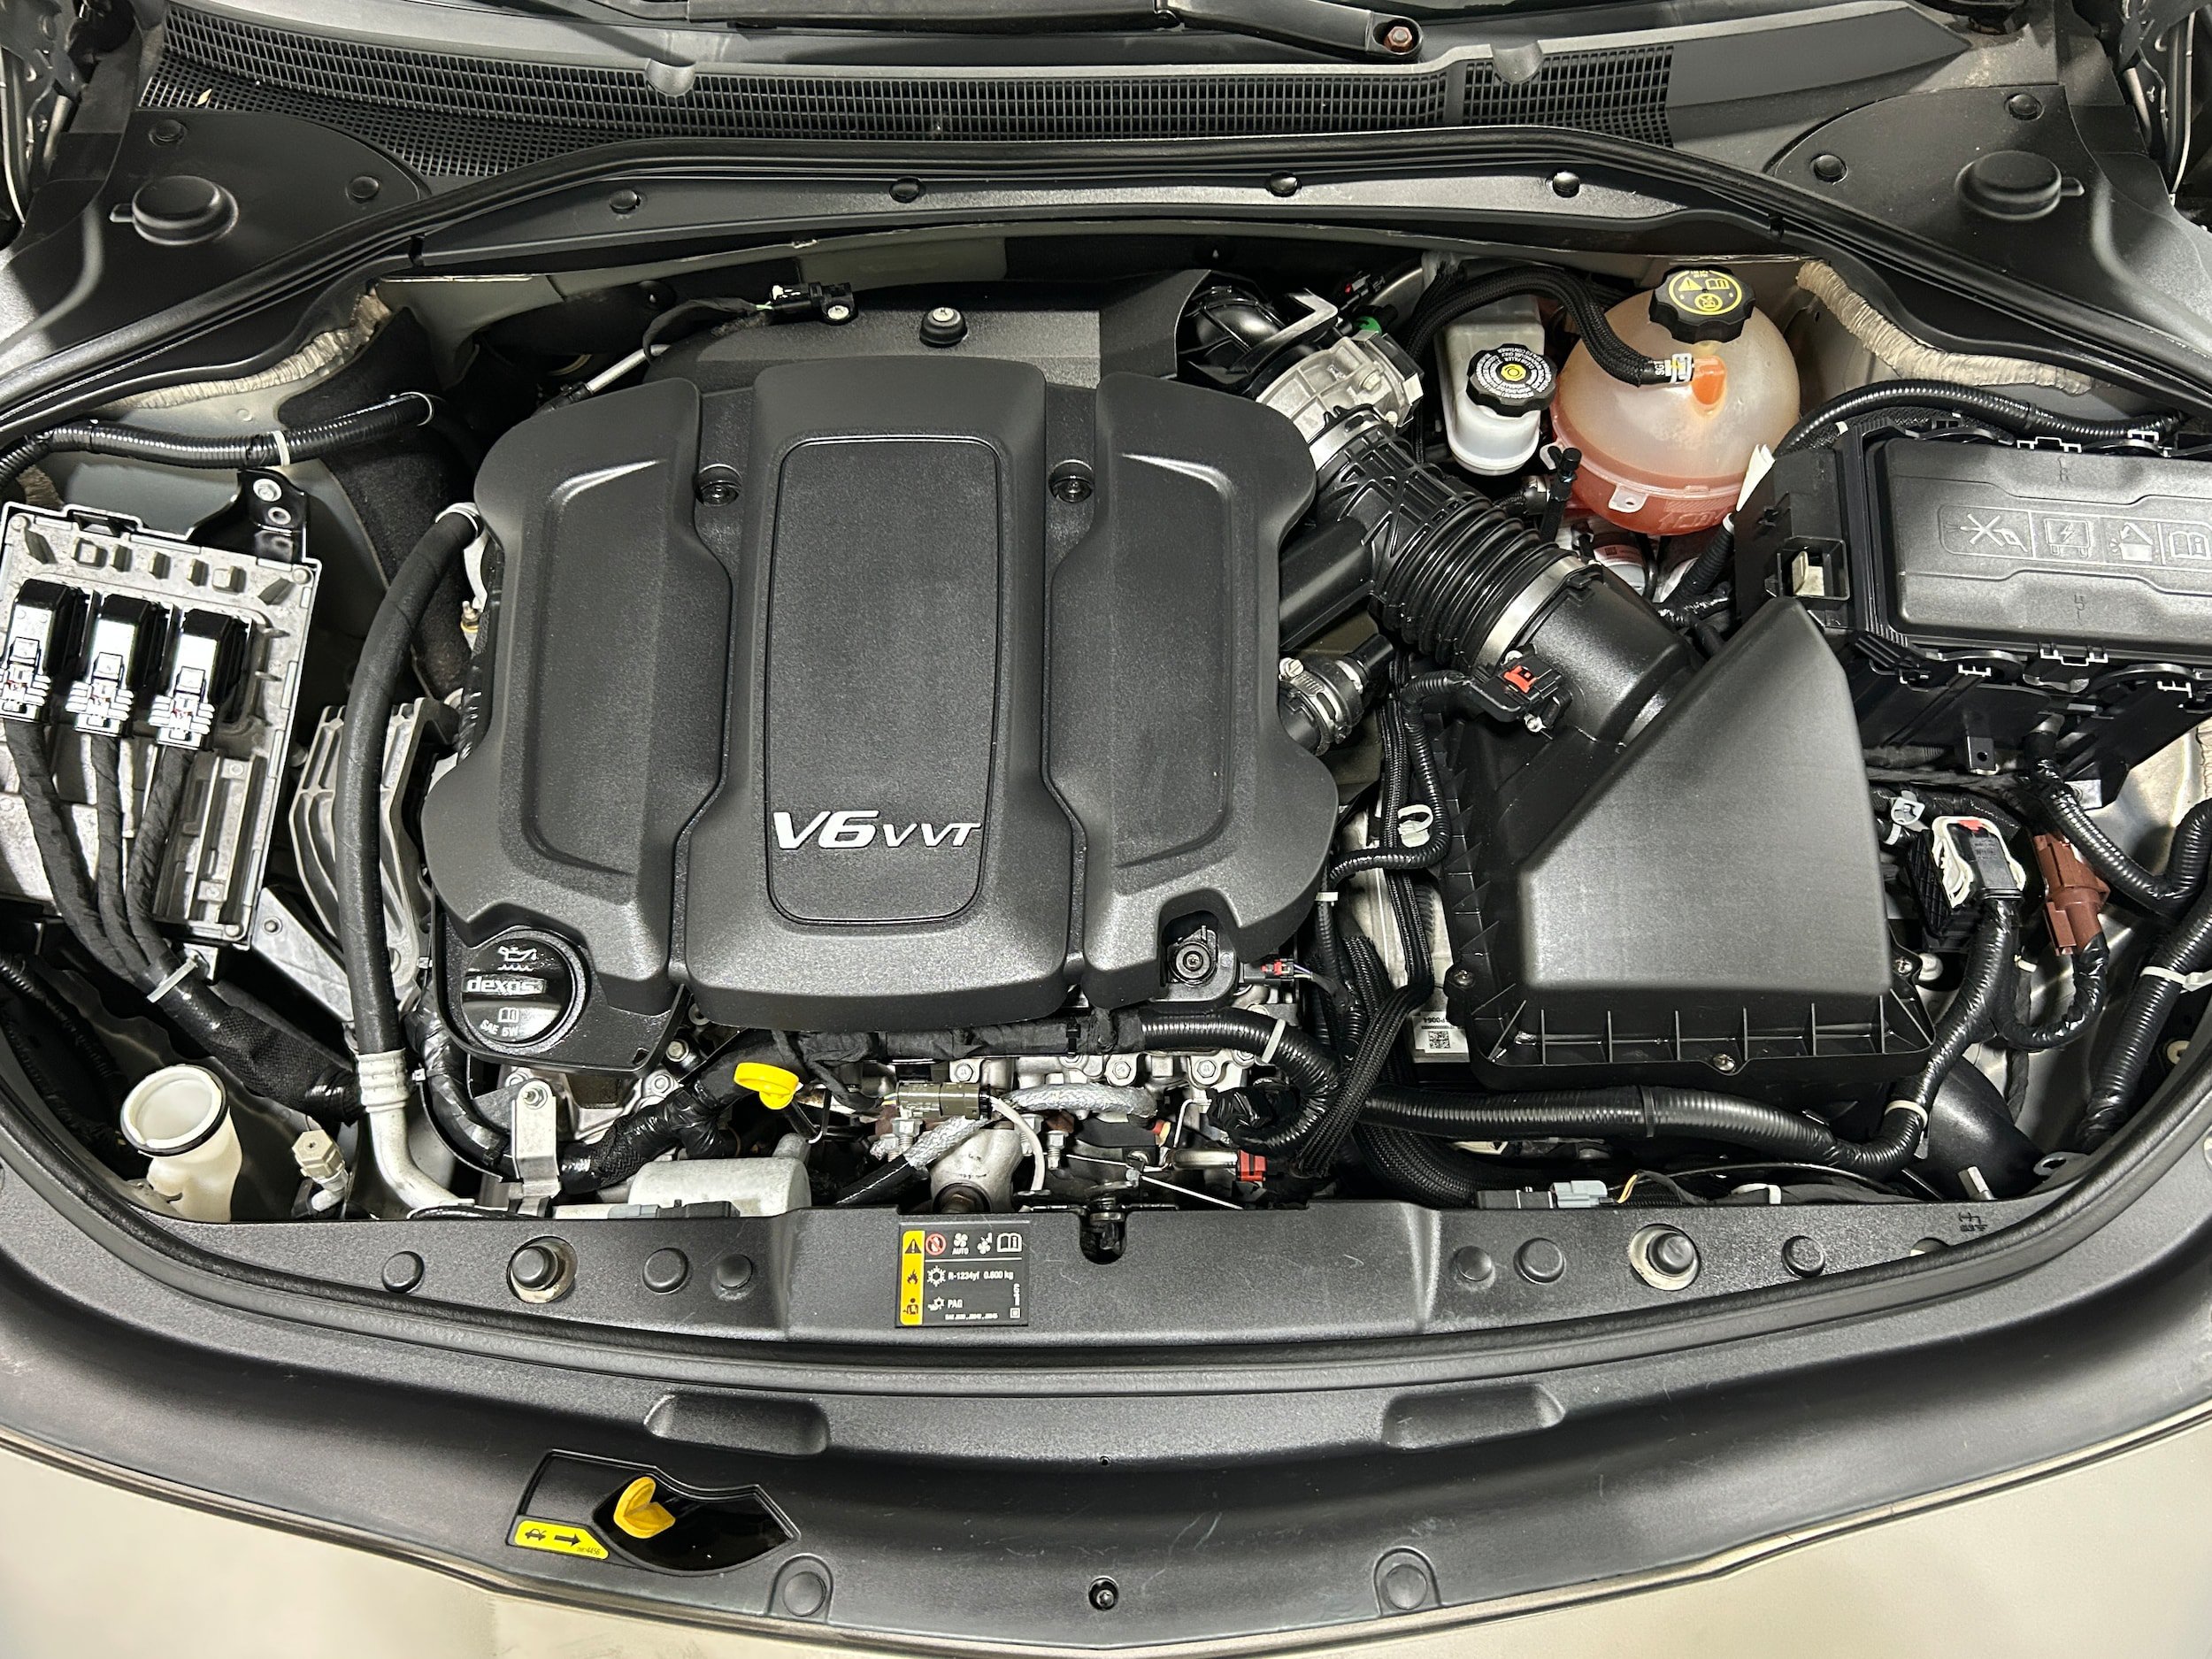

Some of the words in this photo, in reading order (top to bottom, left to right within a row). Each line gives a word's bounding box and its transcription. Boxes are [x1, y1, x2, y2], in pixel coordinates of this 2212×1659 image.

[772, 810, 880, 850] V6
[882, 822, 982, 849] VVT
[480, 1018, 500, 1035] SAE
[951, 1247, 969, 1256] AUTO
[948, 1271, 979, 1281] R-1234yf
[1003, 1270, 1014, 1280] kg
[947, 1299, 963, 1309] PAG
